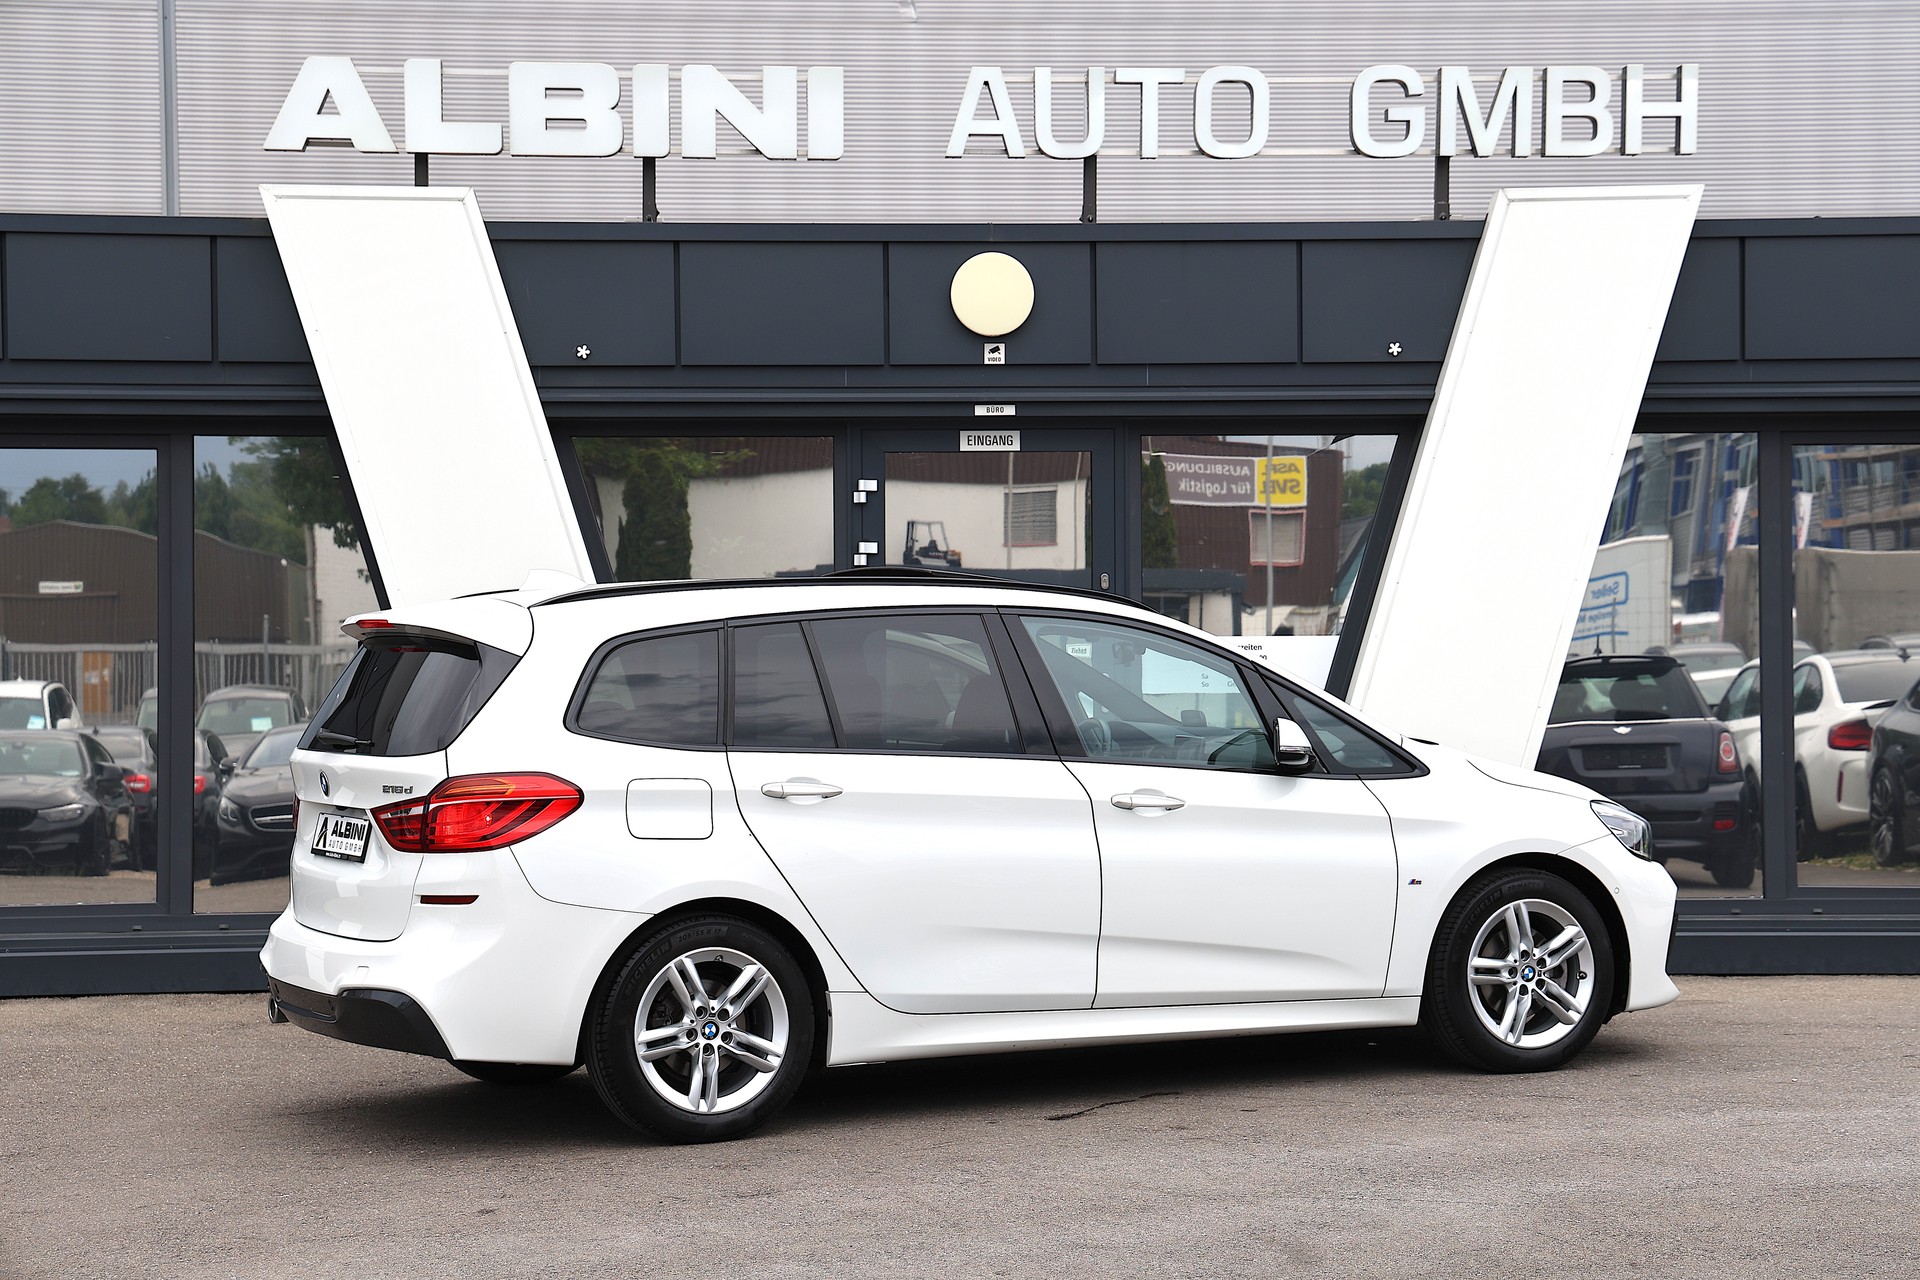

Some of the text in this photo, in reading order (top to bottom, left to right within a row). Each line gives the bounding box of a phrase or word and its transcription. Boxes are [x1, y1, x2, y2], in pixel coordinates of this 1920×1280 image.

[263, 56, 1699, 160] ALBINI AUTO GMBH
[986, 406, 1005, 414] BÜRO
[967, 434, 1014, 447] EINGANG
[332, 820, 366, 841] ALBINI
[328, 839, 362, 852] AUTO GMBH
[677, 929, 704, 943] 205/55
[714, 928, 722, 936] 17
[625, 939, 672, 996] MICHELIN
